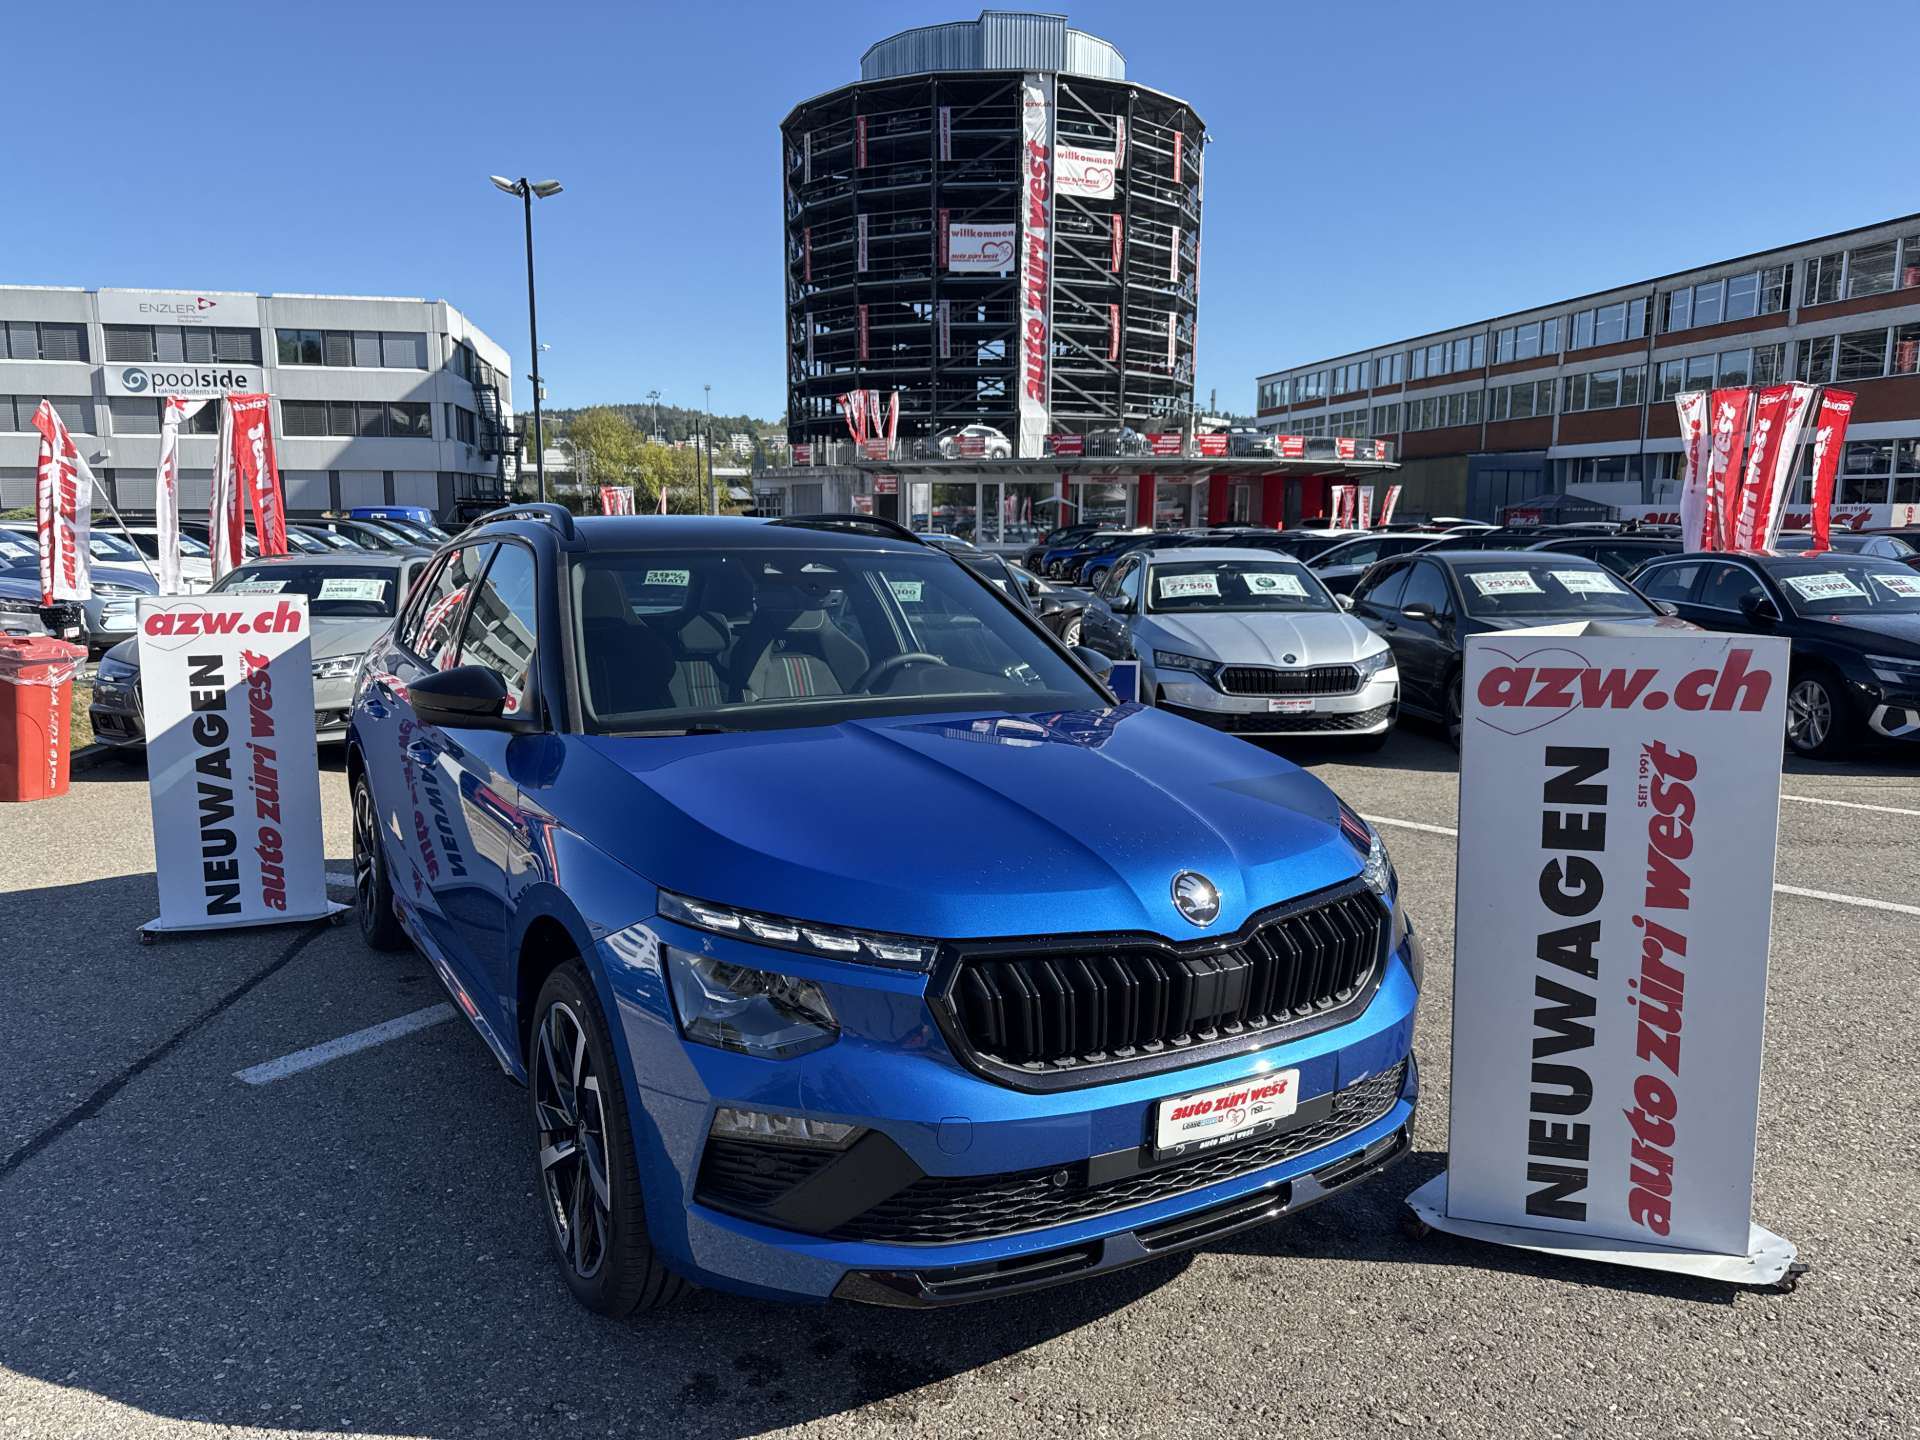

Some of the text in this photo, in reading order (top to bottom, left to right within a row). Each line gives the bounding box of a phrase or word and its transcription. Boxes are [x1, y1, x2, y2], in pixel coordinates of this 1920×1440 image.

[1057, 151, 1114, 165] willkommen
[951, 228, 1014, 238] willkommen
[1023, 139, 1050, 404] auto züri west
[139, 303, 196, 314] ENZLER
[151, 369, 247, 393] poolside
[1713, 402, 1736, 473] west
[1746, 417, 1772, 484] west
[144, 601, 302, 637] azw.ch
[1477, 648, 1773, 711] azw.ch
[187, 655, 241, 917] NEUWAGEN
[240, 648, 287, 912] auto züri west
[1638, 751, 1650, 808] SEIT 1991
[1525, 745, 1610, 1223] NEUWAGEN
[1624, 739, 1699, 1237] auto züri west
[1170, 1079, 1288, 1121] auto züri west
[1199, 1138, 1218, 1149] auto
[1236, 1127, 1255, 1139] west
